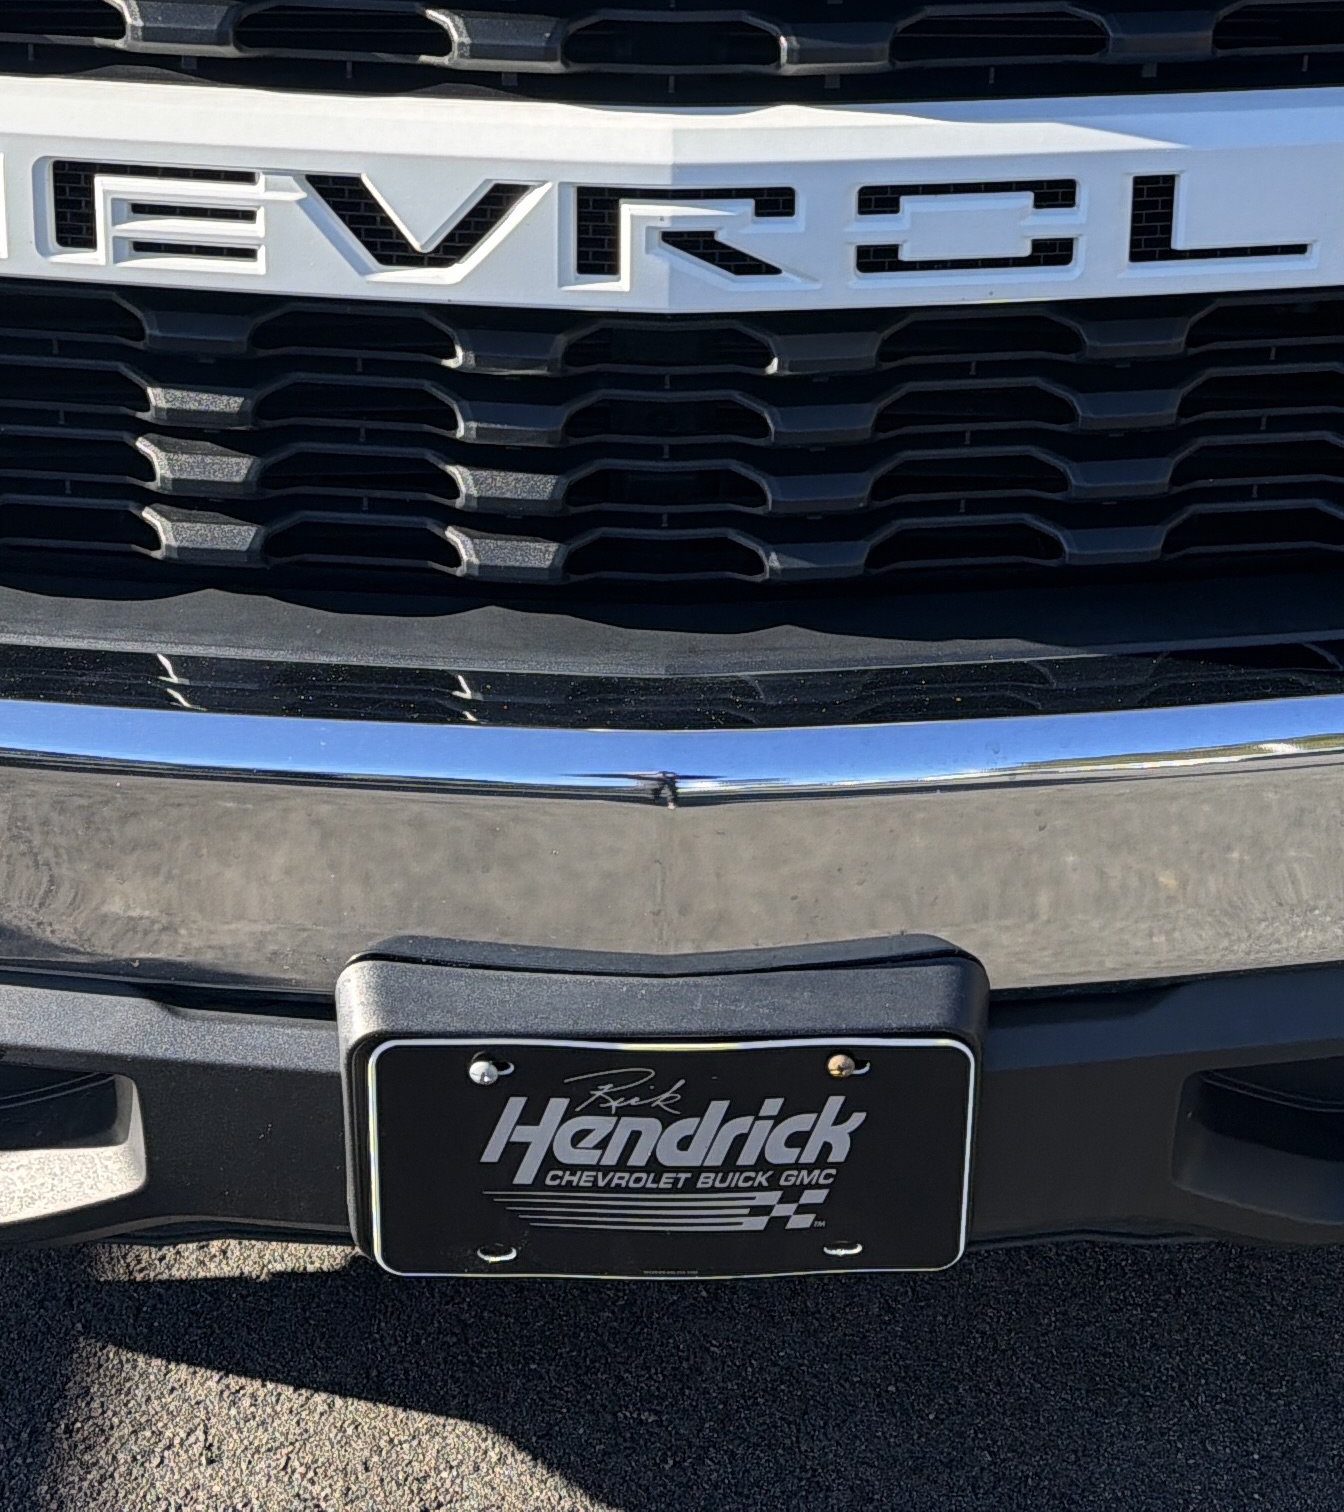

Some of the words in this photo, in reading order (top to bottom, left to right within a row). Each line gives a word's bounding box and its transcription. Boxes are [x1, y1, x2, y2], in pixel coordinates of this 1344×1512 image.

[480, 1095, 867, 1185] Hendrick
[544, 1170, 692, 1189] CHEVROLET
[696, 1170, 774, 1189] BUICK
[778, 1168, 837, 1187] GMC
